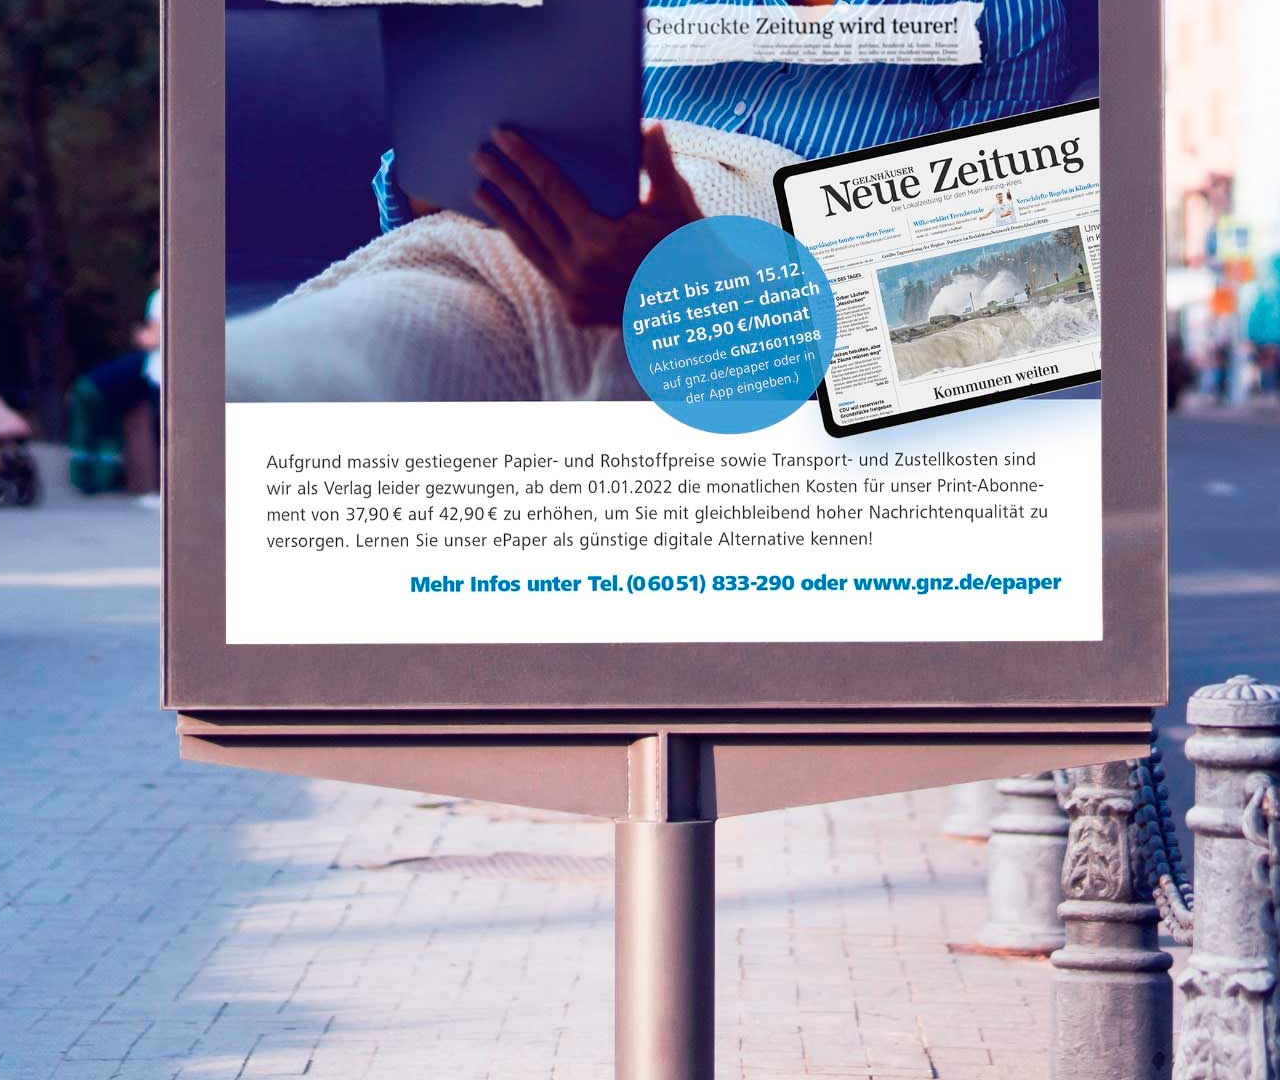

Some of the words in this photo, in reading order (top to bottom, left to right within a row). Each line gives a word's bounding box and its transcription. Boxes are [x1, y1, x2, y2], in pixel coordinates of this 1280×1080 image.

[647, 18, 749, 35] Gedruckte
[757, 18, 833, 38] Zeitung
[841, 18, 885, 34] wird
[893, 18, 958, 34] teurer!
[820, 175, 920, 217] Neue
[930, 137, 1083, 194] Zeitung
[852, 166, 915, 186] GELNHÄUSER
[639, 289, 679, 308] Jetzt
[685, 282, 709, 298] bis
[715, 275, 750, 291] zum
[756, 263, 805, 283] 15.12.
[633, 311, 681, 335] gratis
[686, 301, 739, 320] testen
[759, 282, 820, 306] danach
[652, 333, 686, 350] nur
[649, 345, 727, 375] (Aktionscode
[730, 330, 822, 357] GNZ16011988
[663, 377, 682, 391] auf
[685, 361, 769, 389] gnz.de/epaper
[774, 353, 801, 368] oder
[804, 351, 815, 360] in
[934, 373, 1013, 400] Kommunen
[1016, 362, 1059, 382] weiten
[686, 391, 705, 404] der
[710, 386, 734, 401] App
[737, 372, 799, 393] eingeben.)
[267, 454, 340, 472] Aufgrund
[348, 454, 398, 468] massiv
[406, 454, 497, 472] gestiegener
[505, 454, 558, 471] Papier-
[565, 454, 593, 467] und
[601, 453, 714, 471] Rohstoffpreise
[721, 453, 766, 466] sowie
[773, 453, 852, 470] Transport-
[860, 453, 888, 466] und
[895, 452, 997, 466] Zustellkosten
[1005, 452, 1035, 465] sind
[267, 481, 291, 495] wir
[298, 481, 317, 495] als
[324, 481, 371, 498] Verlag
[379, 480, 420, 494] leider
[426, 484, 518, 498] gezwungen,
[526, 480, 543, 493] ab
[550, 480, 581, 493] dem
[589, 480, 671, 493] 01.01.2022
[679, 480, 700, 493] die
[707, 479, 799, 493] monatlichen
[807, 480, 856, 492] Kosten
[864, 478, 884, 492] für
[892, 482, 931, 492] unser
[938, 478, 1043, 492] Print-Abonne-
[268, 509, 305, 521] ment
[312, 511, 338, 521] von
[409, 506, 433, 520] auf
[504, 510, 520, 520] zu
[528, 506, 596, 521] erhöhen,
[605, 510, 628, 520] um
[636, 506, 657, 519] Sie
[664, 506, 688, 519] mit
[696, 505, 809, 523] gleichbleibend
[817, 505, 862, 519] hoher
[870, 504, 1024, 522] Nachrichtenqualität
[1031, 508, 1047, 518] zu
[267, 537, 348, 551] versorgen.
[357, 534, 408, 547] Lernen
[417, 533, 437, 546] Sie
[445, 537, 487, 546] unser
[494, 533, 547, 550] ePaper
[554, 533, 573, 546] als
[580, 533, 647, 550] günstige
[654, 532, 712, 549] digitale
[719, 532, 804, 545] Alternative
[812, 531, 871, 545] kennen!
[411, 576, 464, 592] Mehr
[471, 575, 520, 592] Infos
[528, 577, 581, 591] unter
[712, 576, 794, 590] 833-290
[801, 574, 847, 590] oder
[854, 574, 1061, 594] www.gnz.de/epaper
